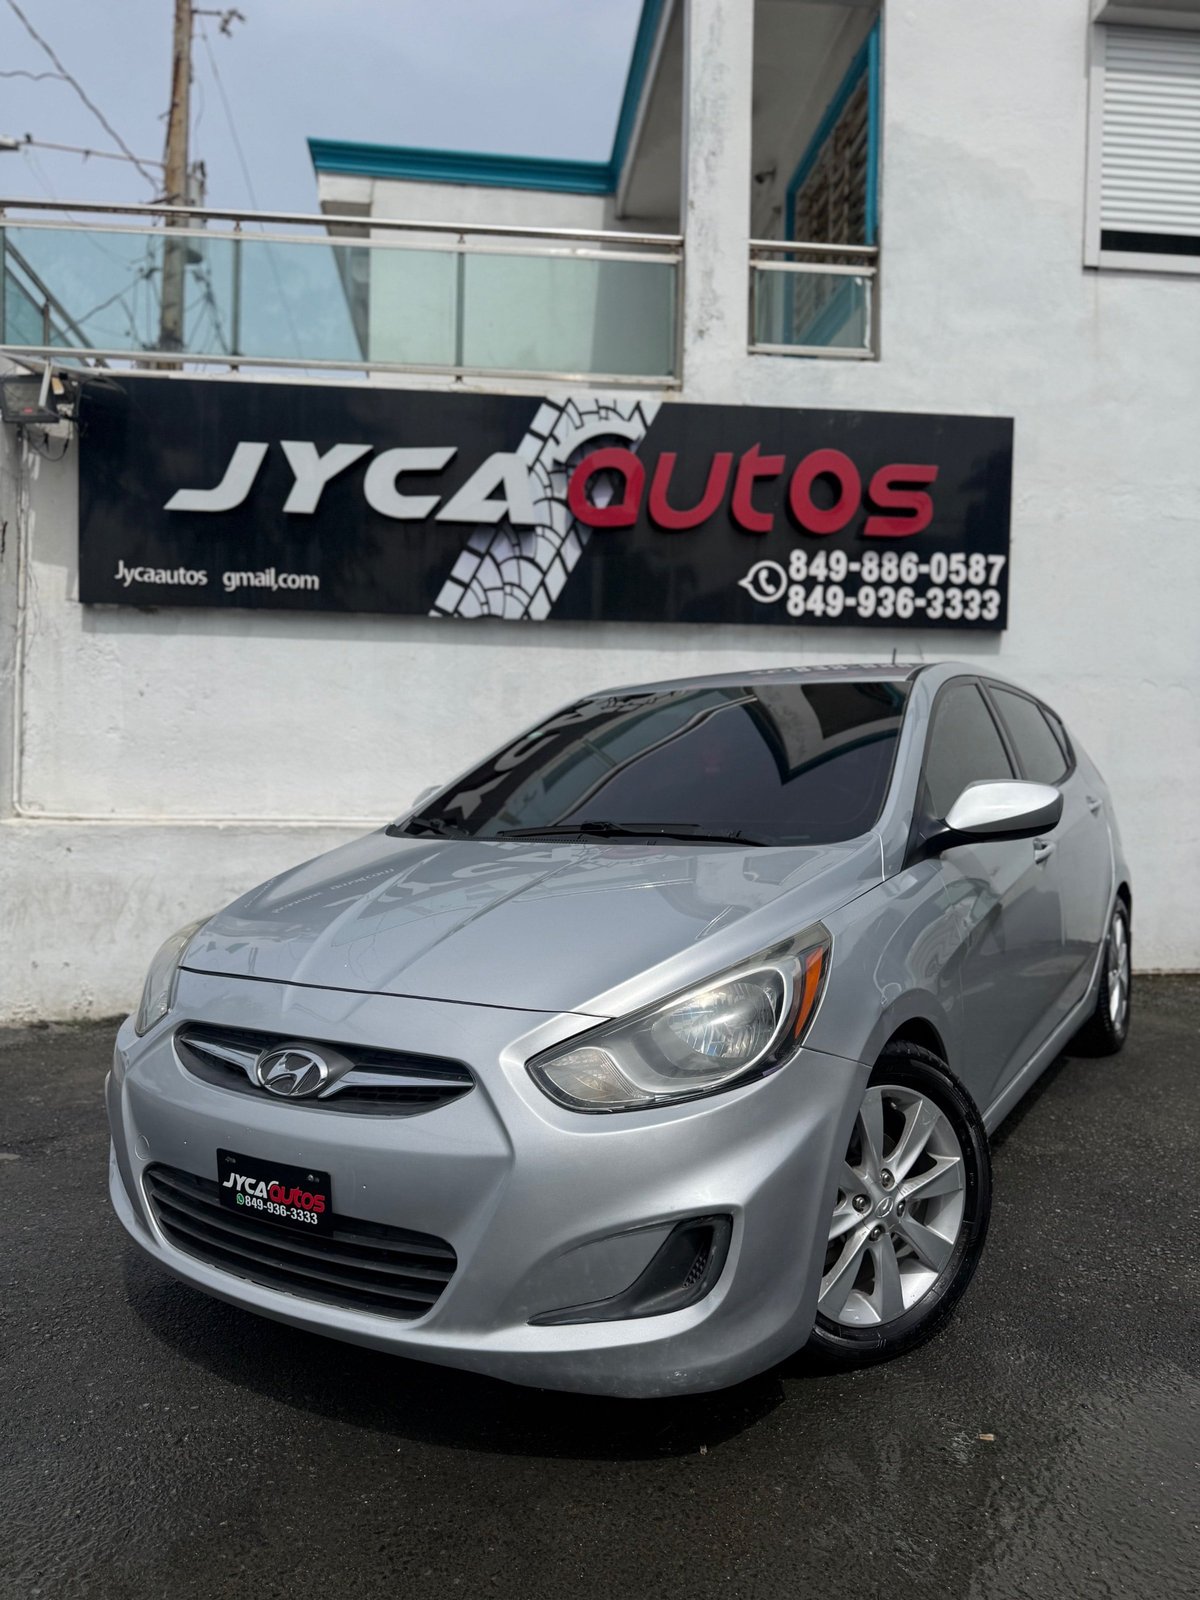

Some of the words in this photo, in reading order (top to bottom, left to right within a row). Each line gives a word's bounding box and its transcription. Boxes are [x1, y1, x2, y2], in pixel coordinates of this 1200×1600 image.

[163, 440, 537, 526] JYCA
[114, 559, 208, 588] Jycaautos
[788, 549, 1006, 586] 849-886-0587
[786, 584, 1001, 621] 849-936-3333
[222, 1172, 268, 1199] JYCA
[244, 1195, 318, 1225] 849-936-3333
